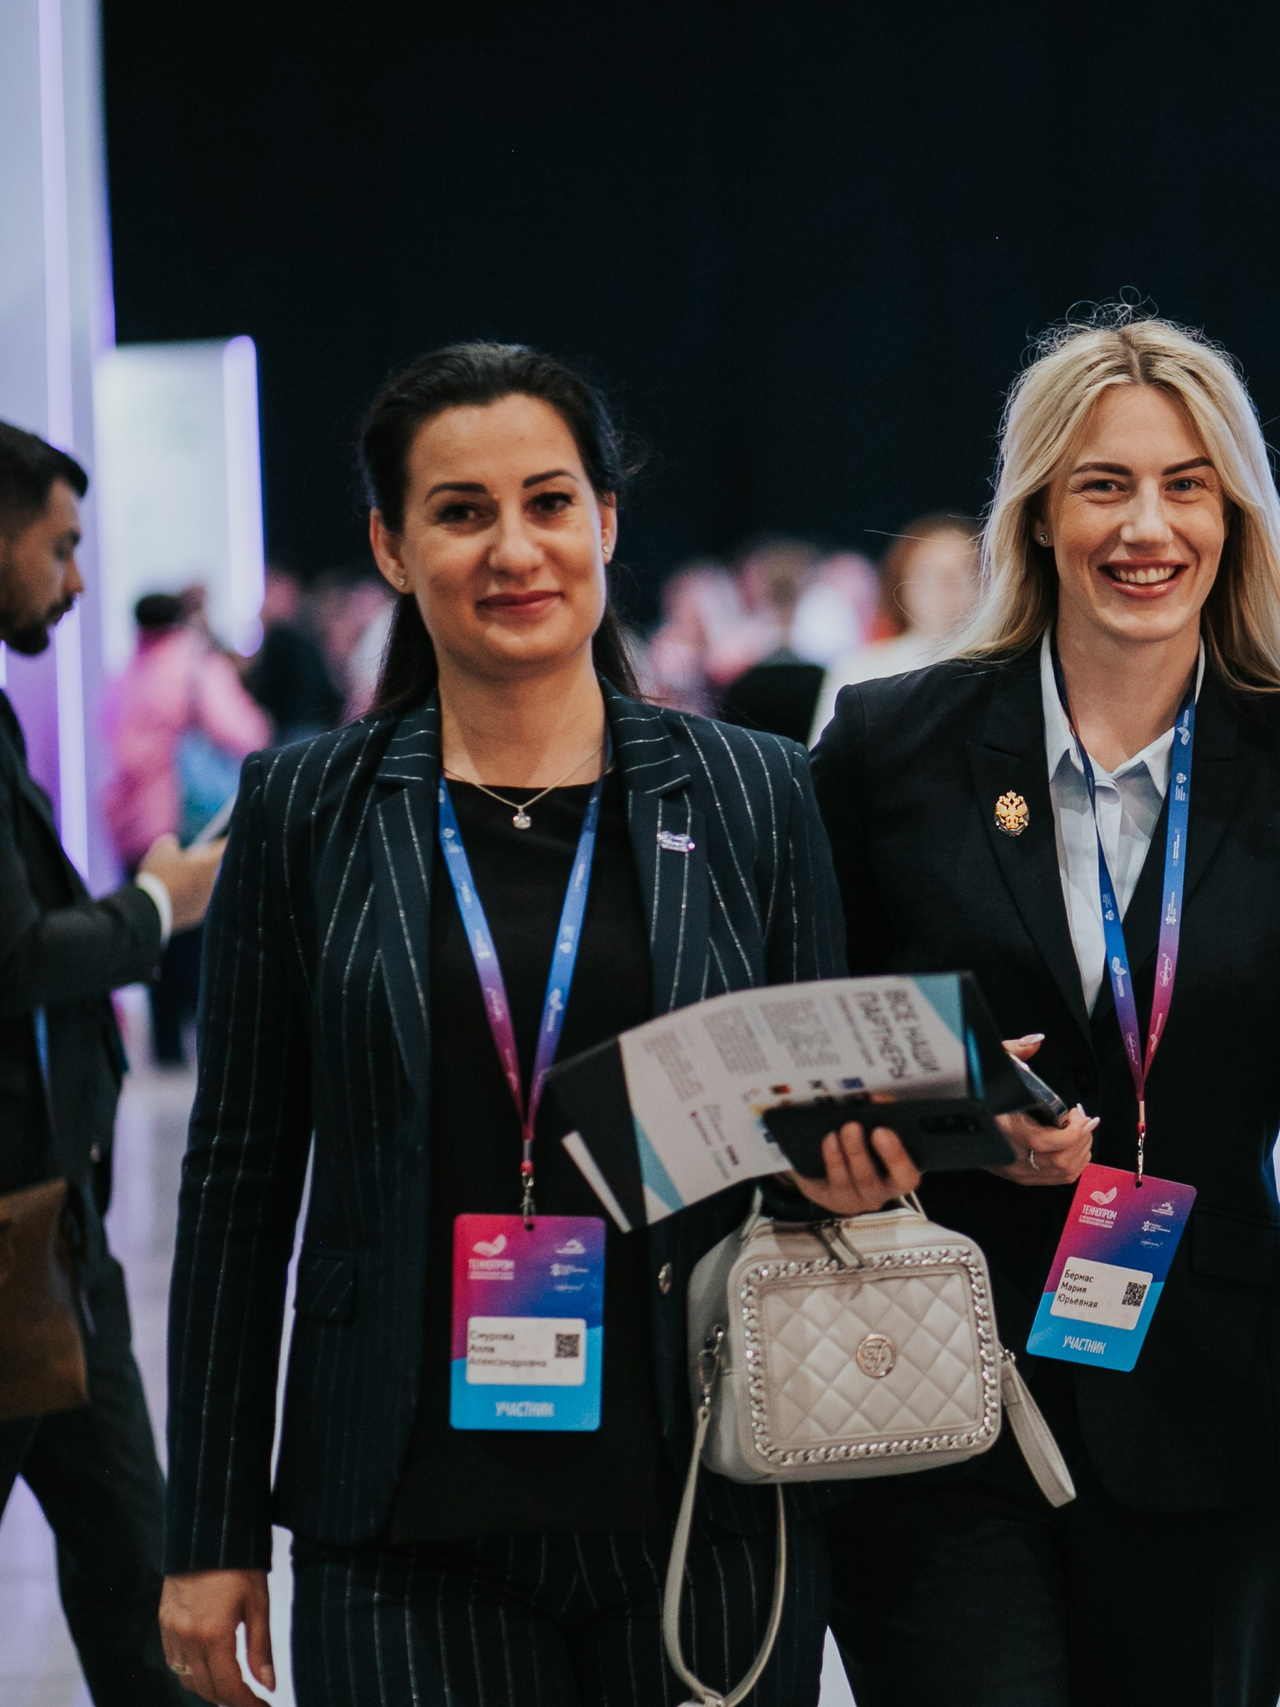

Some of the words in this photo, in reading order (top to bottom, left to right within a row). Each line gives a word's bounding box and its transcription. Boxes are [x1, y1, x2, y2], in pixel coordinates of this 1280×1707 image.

[1064, 1269, 1094, 1283] Бермас
[1061, 1281, 1087, 1294] Мария
[1062, 1334, 1107, 1355] УЧАСТНИК
